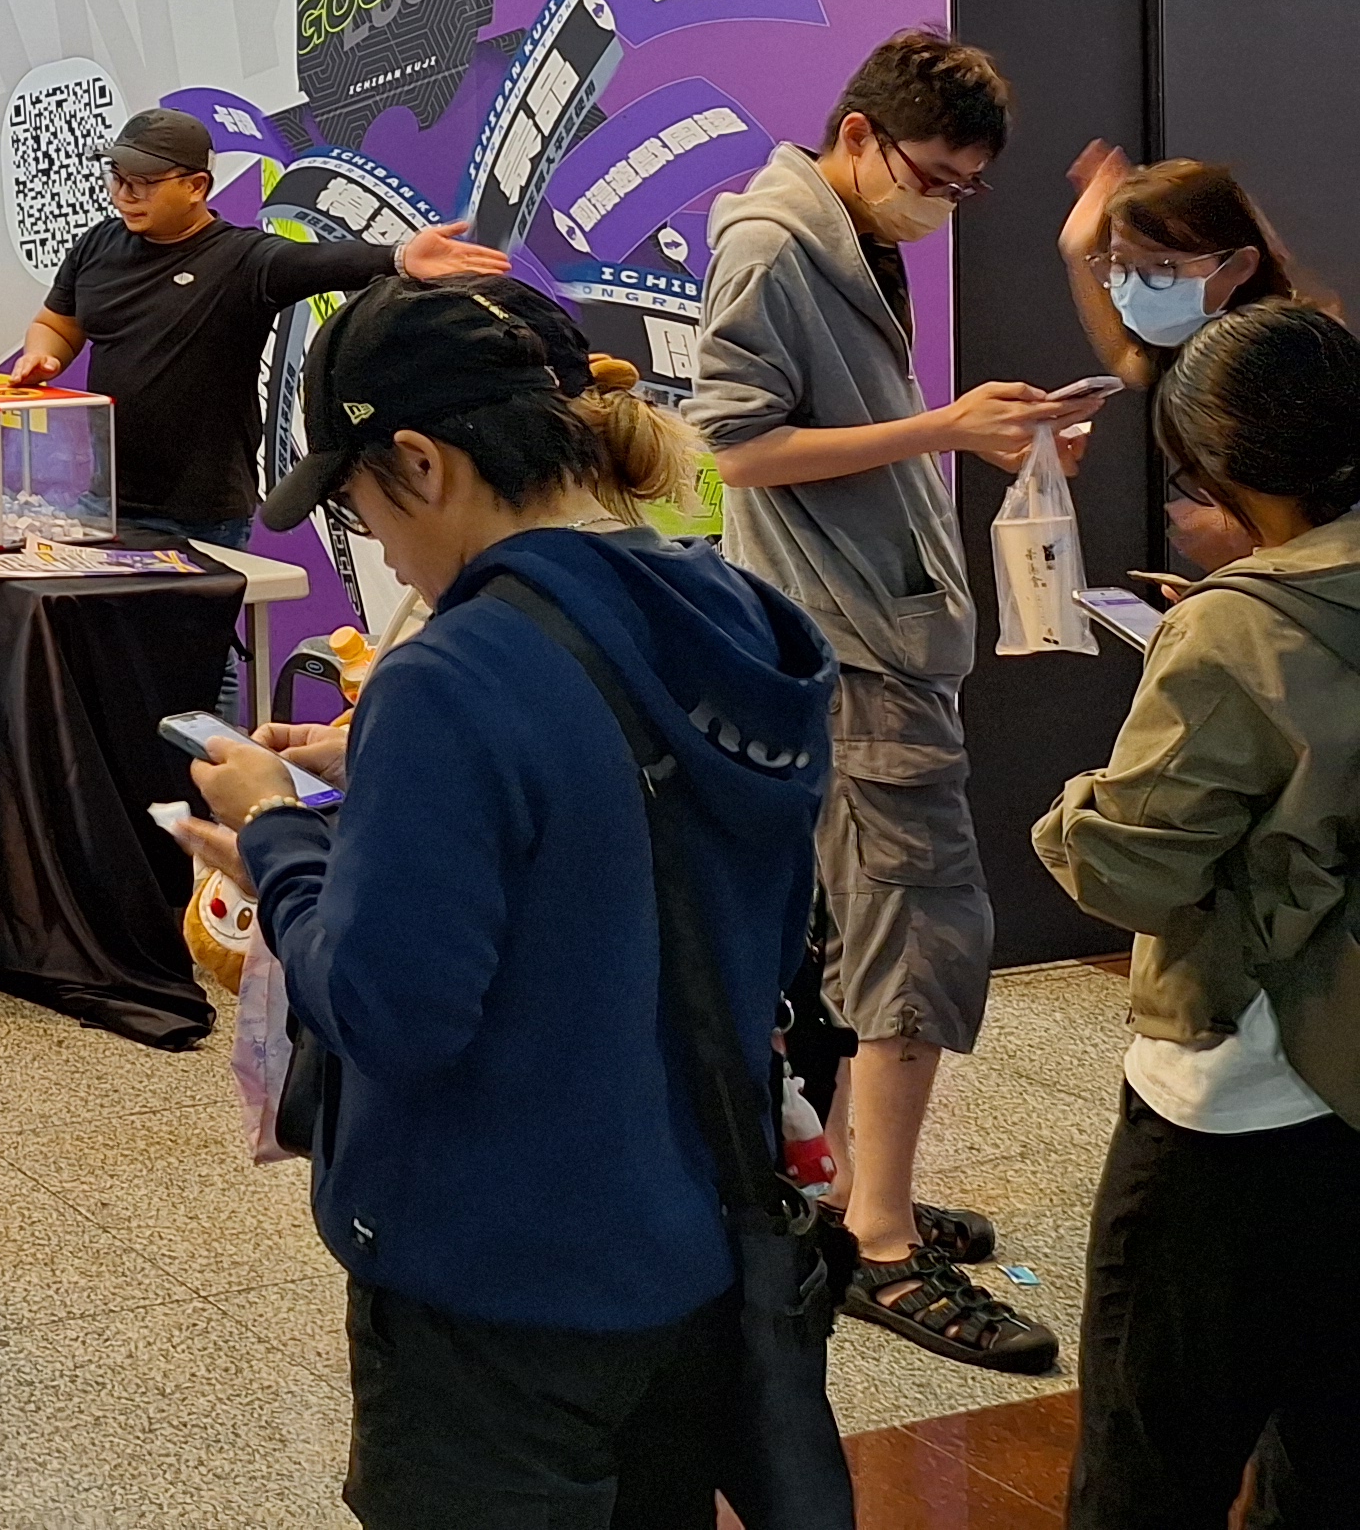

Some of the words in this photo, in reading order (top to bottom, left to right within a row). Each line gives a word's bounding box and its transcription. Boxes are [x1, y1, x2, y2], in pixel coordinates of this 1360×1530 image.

[348, 71, 401, 95] ICHIBAN
[405, 56, 438, 75] KUJI
[329, 147, 415, 199] ICHIBAN
[600, 266, 698, 297] ICHIB
